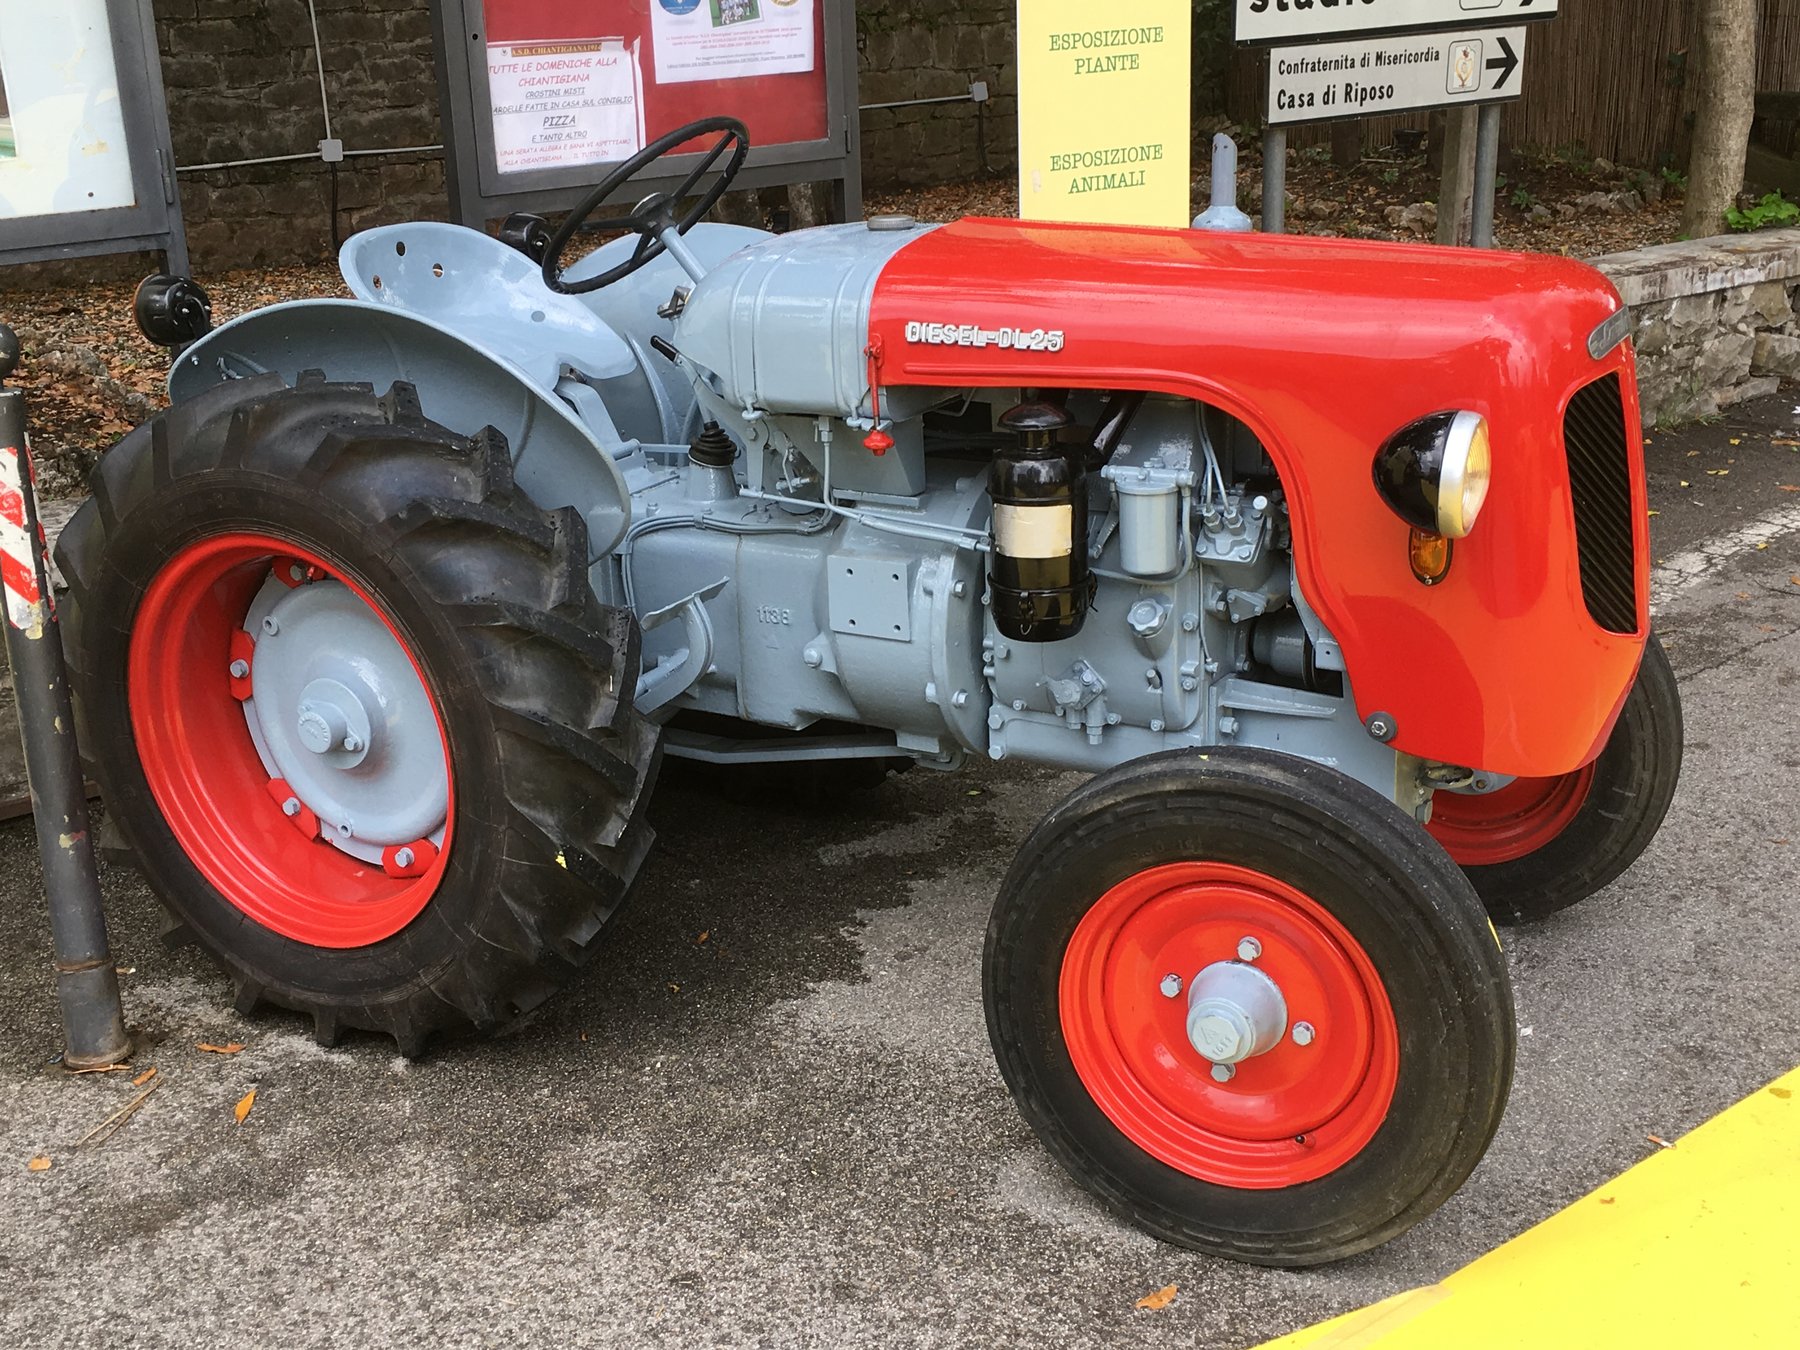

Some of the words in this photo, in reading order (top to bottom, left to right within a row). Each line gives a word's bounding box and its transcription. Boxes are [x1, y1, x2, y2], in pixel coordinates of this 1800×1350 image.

[1049, 27, 1163, 51] ESPOSIZIONE
[490, 63, 519, 75] TUTTE
[522, 63, 532, 72] LE
[536, 59, 591, 71] DOMENICHE
[596, 57, 617, 66] ALLA
[1075, 54, 1139, 74] PIANTE
[1278, 52, 1355, 75] Confraternita
[1360, 52, 1370, 67] di
[1375, 47, 1440, 67] Misericordia
[519, 74, 589, 86] CHIANTIGIANA
[526, 89, 561, 98] CROSTINI
[564, 87, 585, 95] MISTI
[1277, 88, 1314, 109] Casa
[1322, 85, 1336, 104] di
[1344, 82, 1394, 105] Riposo
[525, 103, 548, 111] FATTE
[562, 100, 580, 108] CASA
[597, 96, 633, 105] CONIGLIO
[543, 115, 576, 127] PIZZA
[540, 133, 563, 142] TANTO
[565, 131, 587, 140] ALTRO
[1050, 144, 1163, 172] ESPOSIZIONE
[1068, 170, 1146, 194] ANIMALI
